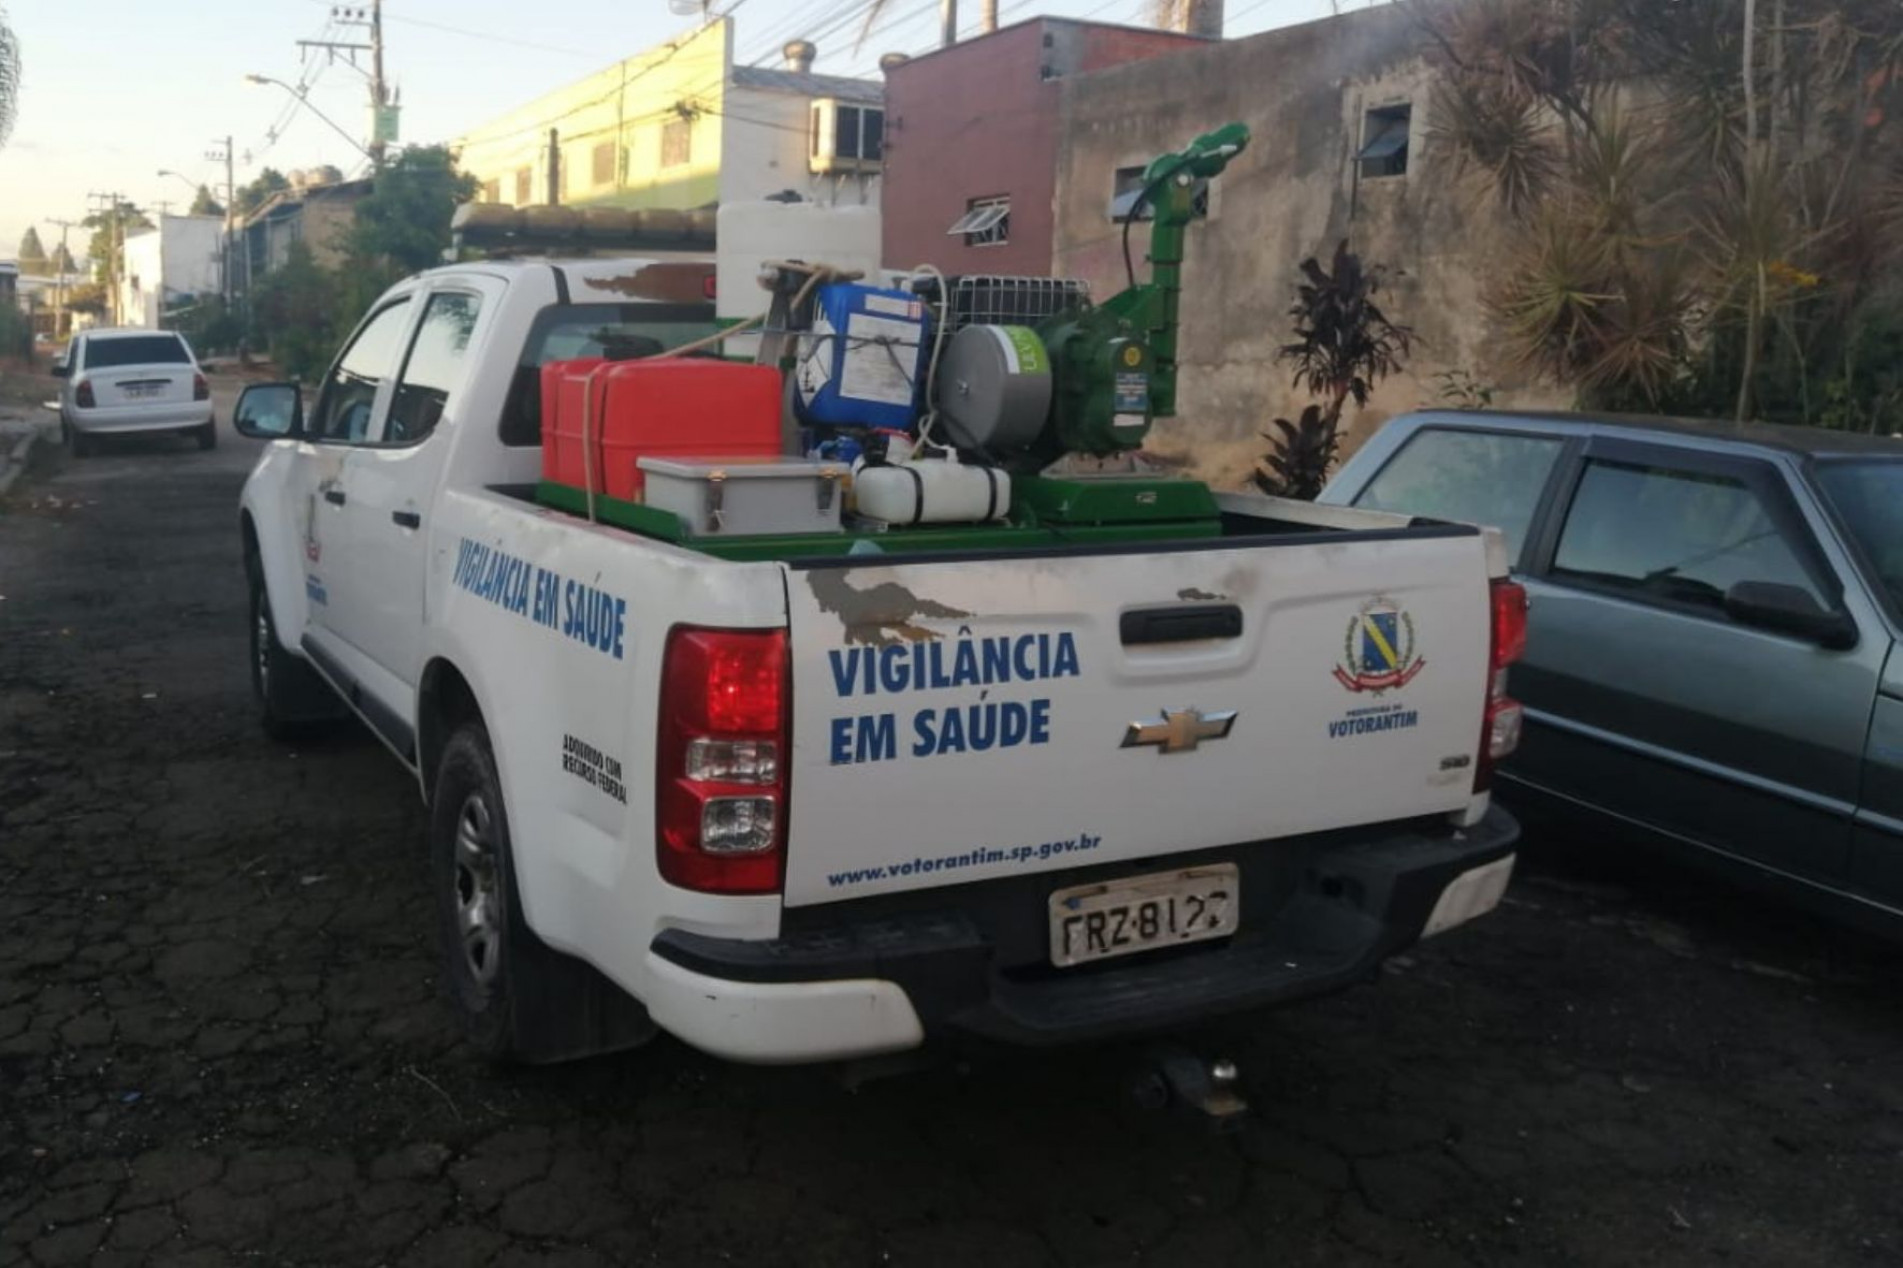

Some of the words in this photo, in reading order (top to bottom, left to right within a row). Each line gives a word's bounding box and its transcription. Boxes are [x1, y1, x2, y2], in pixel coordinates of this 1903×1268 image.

[453, 537, 532, 617] VIGILÂNCIA
[532, 568, 560, 630] EM
[563, 571, 626, 661] SAÚDE
[829, 625, 1079, 697] VIGILÂNCIA
[829, 714, 896, 766] EM
[911, 690, 1051, 757] SAÚDE
[1328, 710, 1418, 739] VOTORANTIM
[562, 753, 597, 786] RECURSO
[827, 833, 1102, 888] www.votorantim.sp.gov.br
